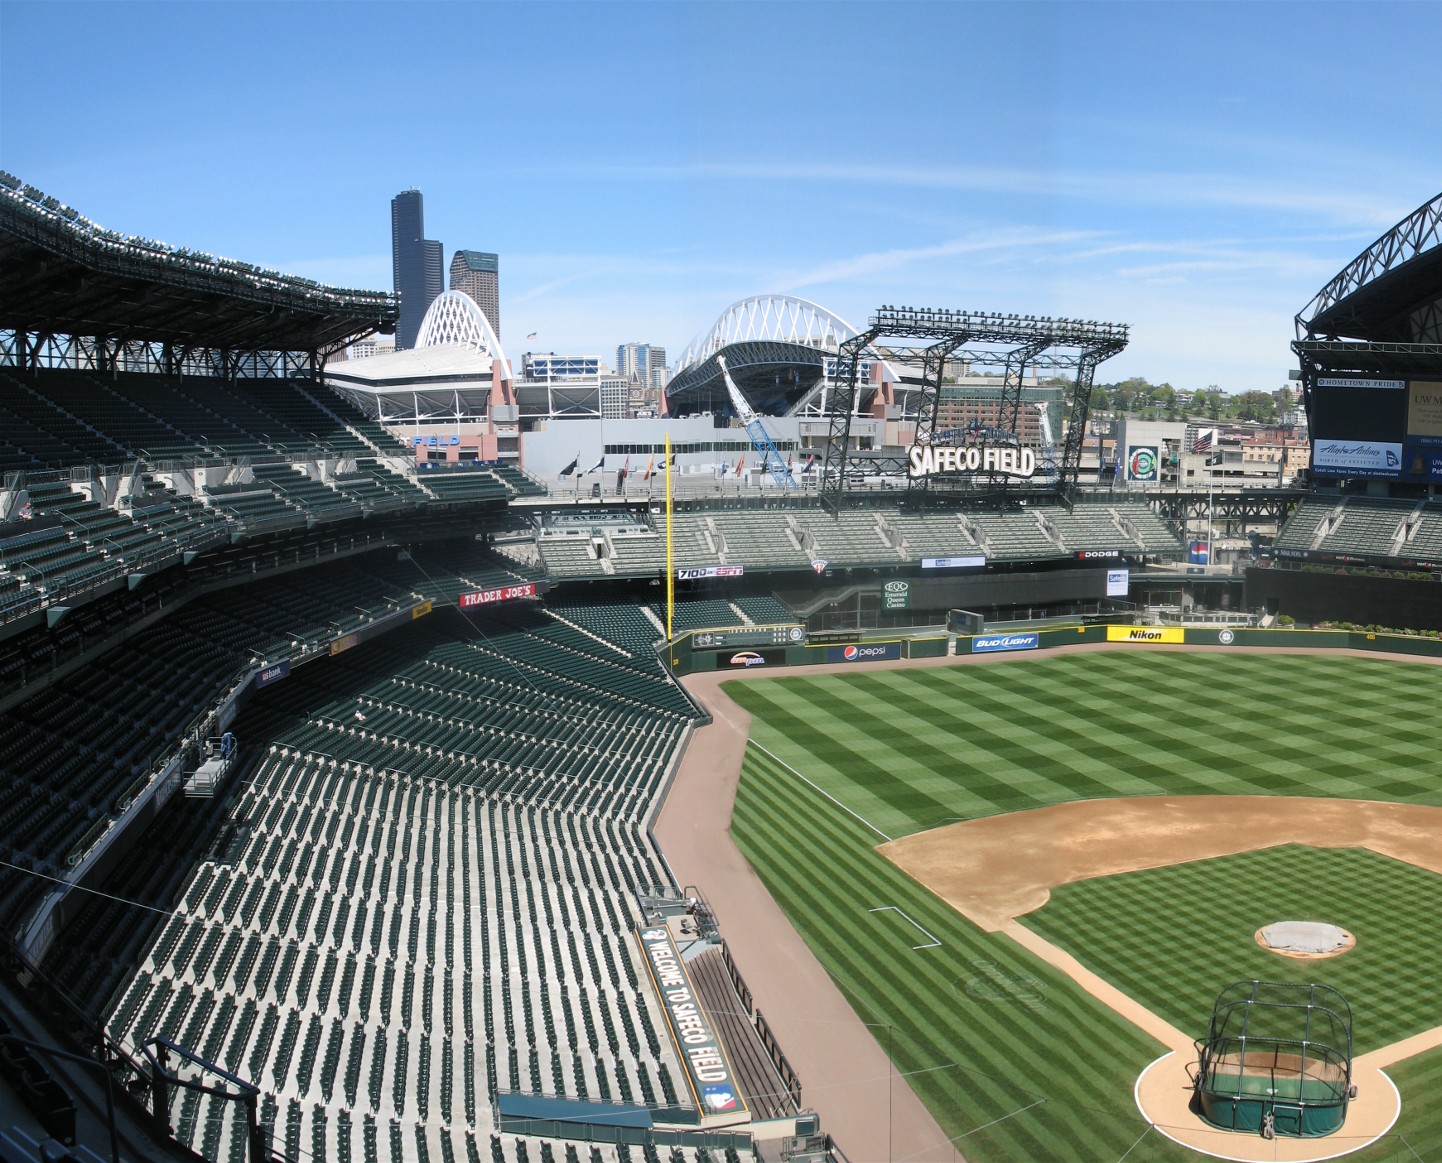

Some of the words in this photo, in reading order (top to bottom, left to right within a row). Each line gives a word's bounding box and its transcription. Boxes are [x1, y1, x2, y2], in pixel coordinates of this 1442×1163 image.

[1415, 395, 1432, 404] UW
[412, 435, 460, 446] FIELD
[1320, 444, 1349, 454] Alaska
[1348, 445, 1381, 456] Airlines
[909, 446, 980, 477] SAFECO
[983, 446, 1036, 477] FIELD
[1085, 550, 1118, 558] DODGE
[888, 583, 906, 591] EQC
[464, 589, 502, 606] TRADER
[505, 585, 531, 599] JOE'S
[1129, 629, 1162, 640] Nikon
[976, 638, 1001, 648] BUD
[1004, 637, 1035, 647] LIGHT
[859, 646, 886, 657] pepsi
[648, 940, 685, 987] WELCOME
[666, 987, 692, 1003] TO
[671, 1003, 709, 1044] SAFECO
[687, 1046, 728, 1083] FIELD
